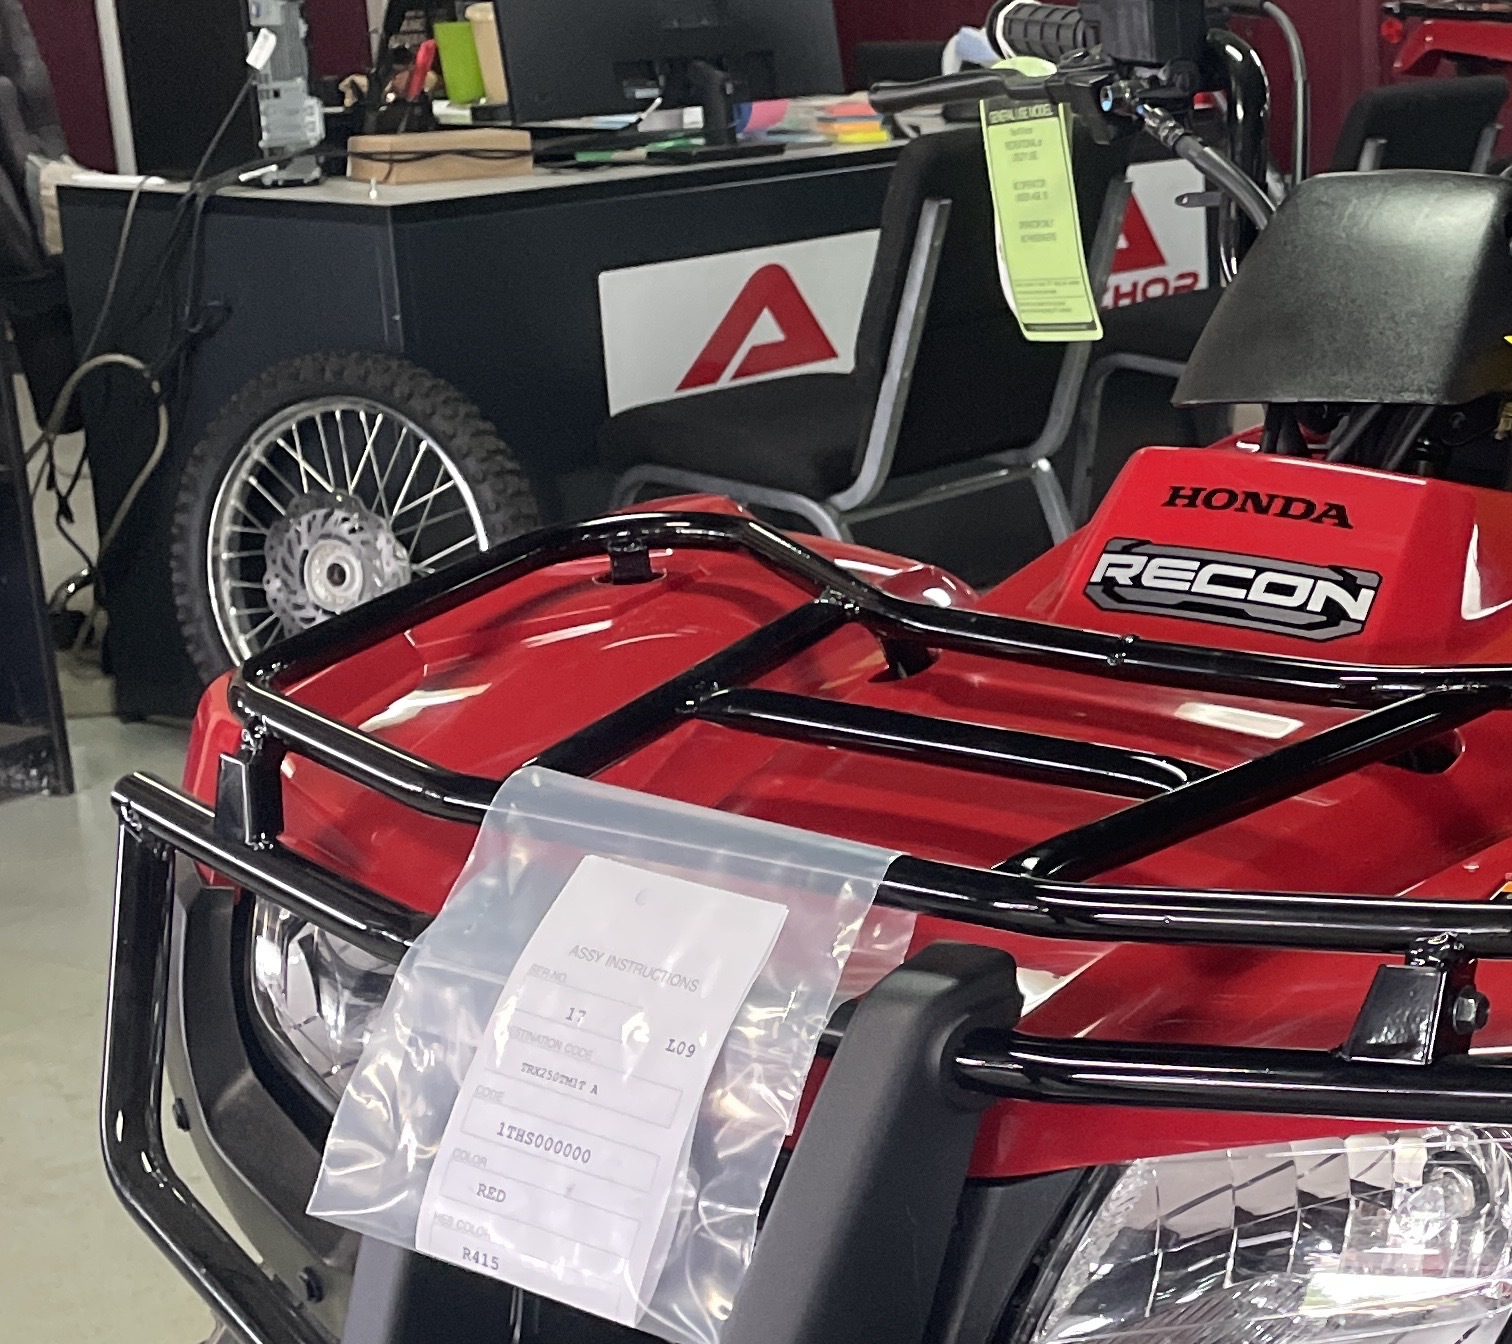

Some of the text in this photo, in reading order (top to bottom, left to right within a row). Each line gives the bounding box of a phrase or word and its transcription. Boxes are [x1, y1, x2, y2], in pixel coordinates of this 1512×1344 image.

[1101, 271, 1199, 311] HOP
[1161, 485, 1354, 530] HONDA
[1089, 552, 1376, 621] RECON
[569, 944, 700, 993] ASSY INSTRUCTIONS
[665, 1038, 696, 1058] L09
[590, 1084, 599, 1096] A
[452, 1147, 488, 1168] COLOR
[496, 1122, 592, 1164] 1THS000000
[476, 1182, 506, 1203] RED
[462, 1246, 499, 1270] R415
